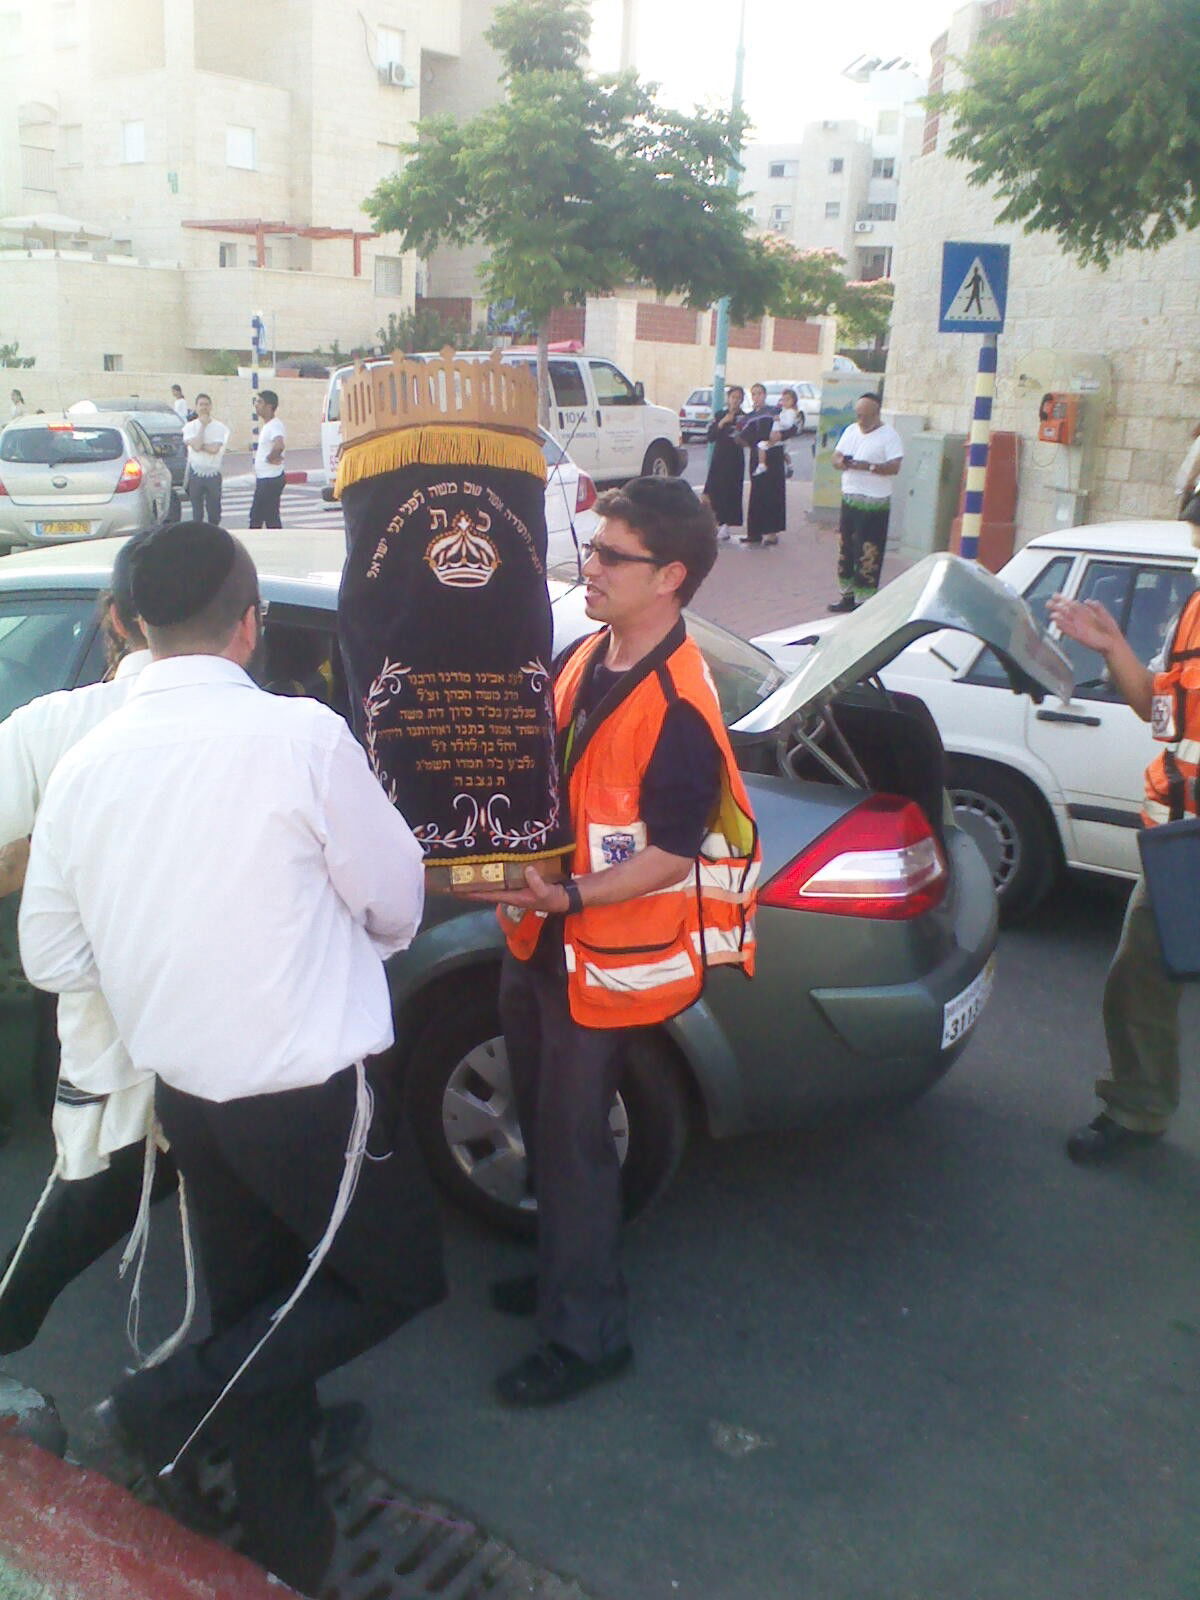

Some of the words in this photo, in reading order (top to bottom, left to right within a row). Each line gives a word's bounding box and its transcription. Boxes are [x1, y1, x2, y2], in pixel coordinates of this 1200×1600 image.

[428, 482, 458, 498] משה
[463, 481, 483, 497] שם
[398, 489, 426, 516] לפני
[387, 515, 404, 533] בני
[366, 537, 389, 580] ישראל
